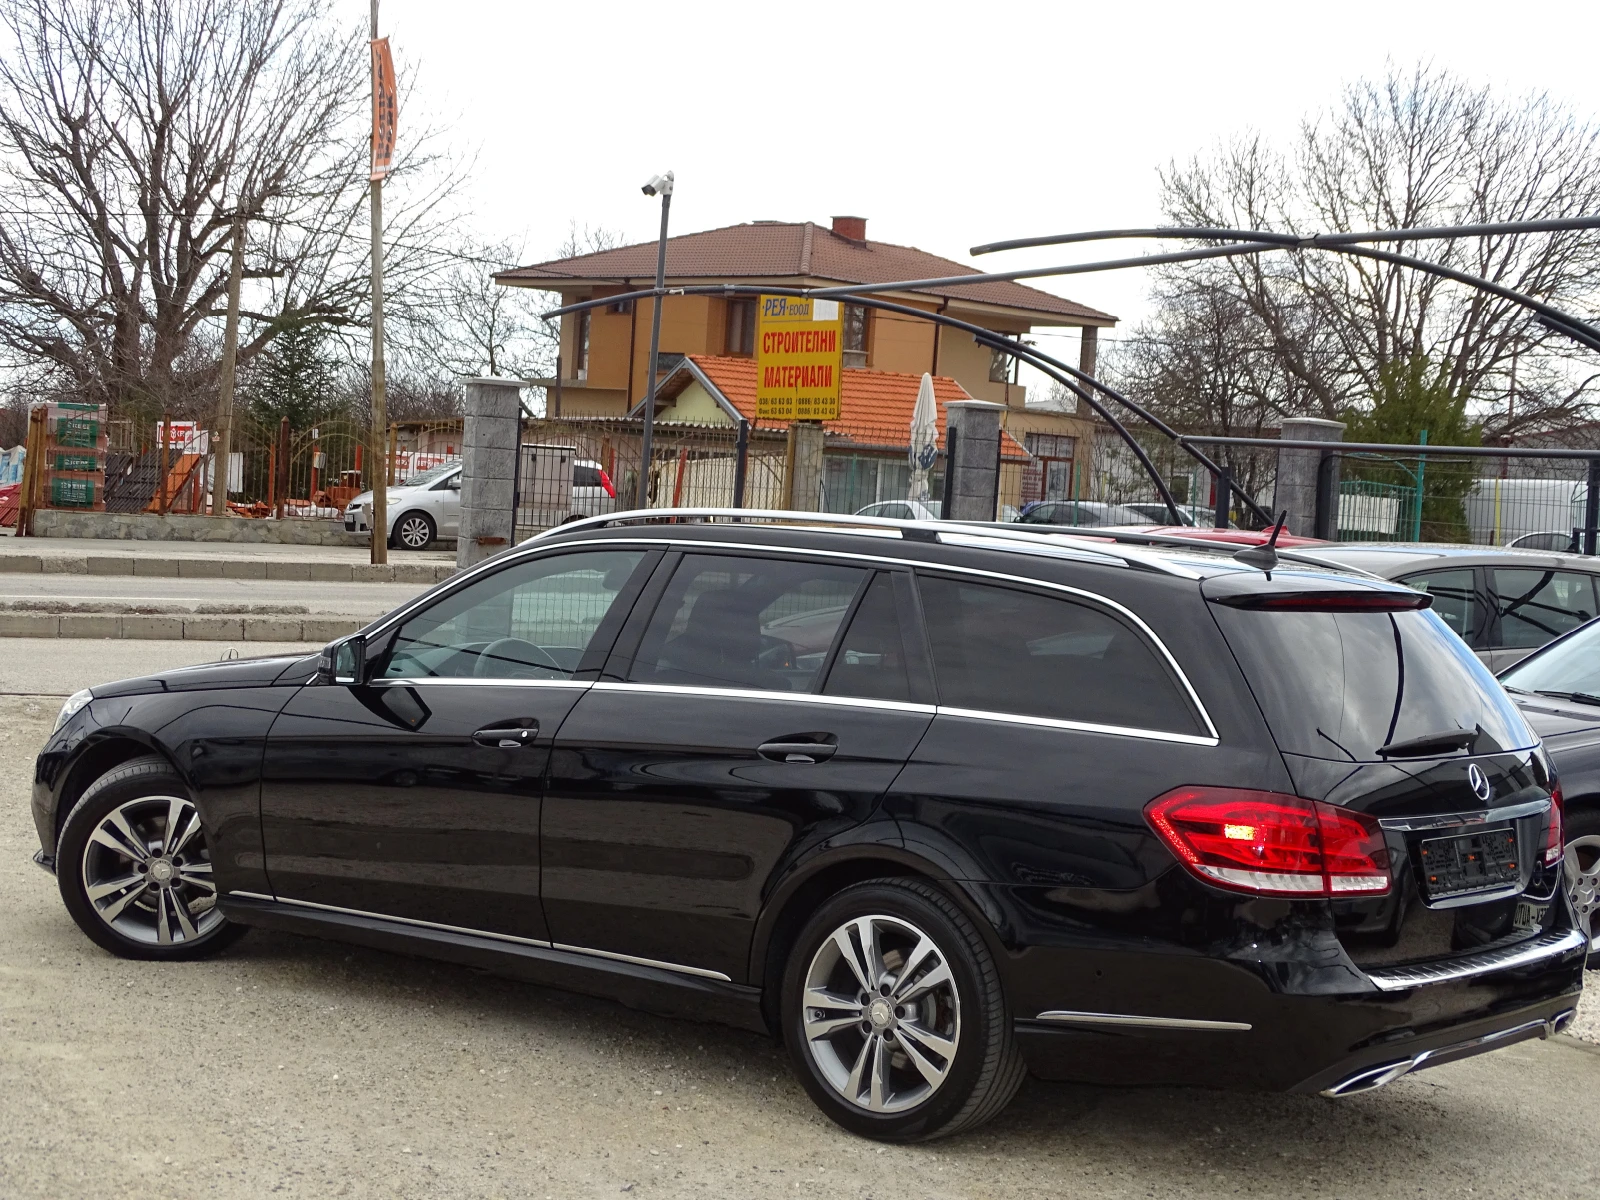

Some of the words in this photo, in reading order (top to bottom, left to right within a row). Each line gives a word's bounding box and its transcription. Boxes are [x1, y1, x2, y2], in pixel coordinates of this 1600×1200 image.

[789, 303, 809, 317] ЕООД
[763, 330, 836, 354] СТРОИТЕЛНИ
[764, 365, 832, 388] МАТЕРИАЛИ
